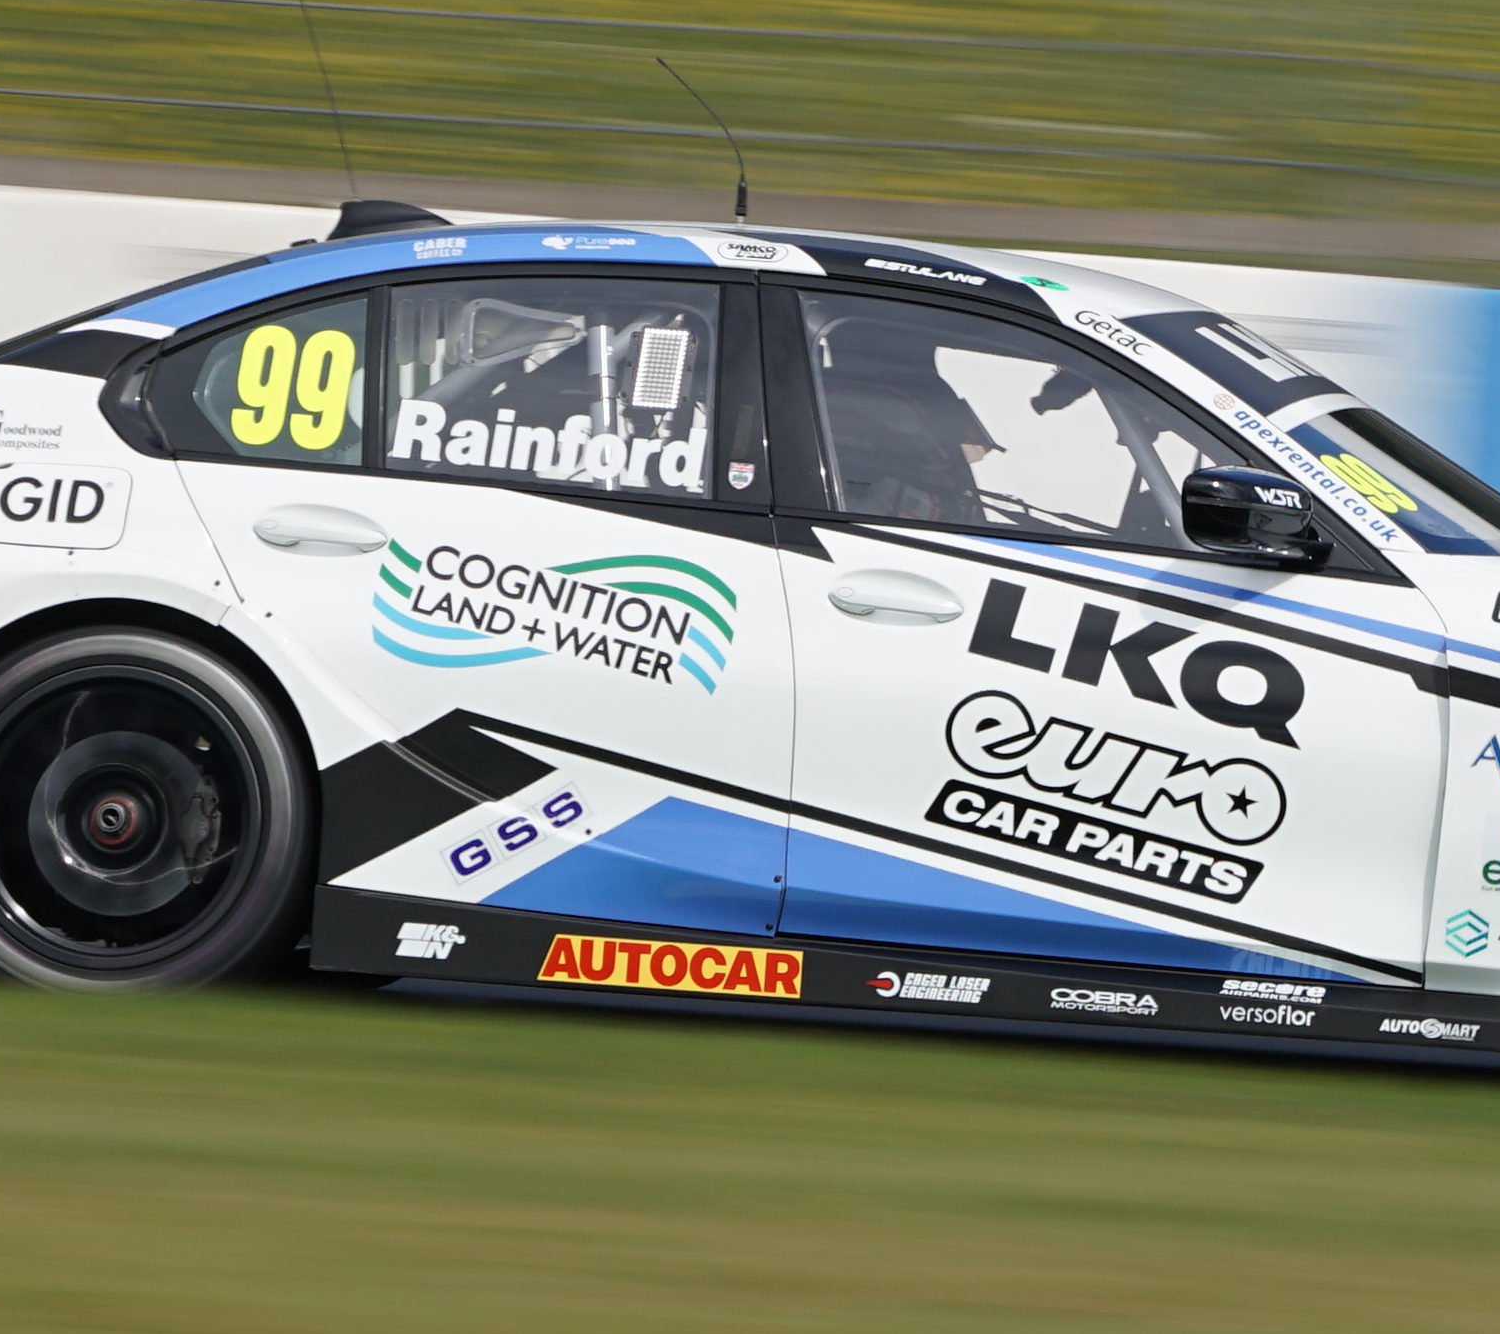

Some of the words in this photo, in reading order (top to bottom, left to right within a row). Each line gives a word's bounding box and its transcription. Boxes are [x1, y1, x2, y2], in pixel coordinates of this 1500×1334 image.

[1074, 310, 1152, 357] Getac
[231, 325, 356, 450] 99
[390, 398, 708, 490] Rainford
[1234, 410, 1399, 544] apexrental.co.uk
[1254, 486, 1303, 509] WSR
[411, 586, 515, 636] LAND
[556, 626, 673, 685] WATER
[426, 545, 691, 645] COGNITION
[969, 578, 1305, 750] LKQ
[945, 689, 1287, 846] euro
[449, 790, 583, 876] GSS
[941, 787, 1060, 848] CAR
[1066, 821, 1249, 899] PARTS
[542, 938, 802, 996] AUTOCAR
[899, 986, 983, 1004] ENGINEERING
[1050, 1000, 1159, 1016] MOTORSPORT
[1051, 988, 1159, 1008] COBRA
[1219, 1004, 1316, 1027] versoflor
